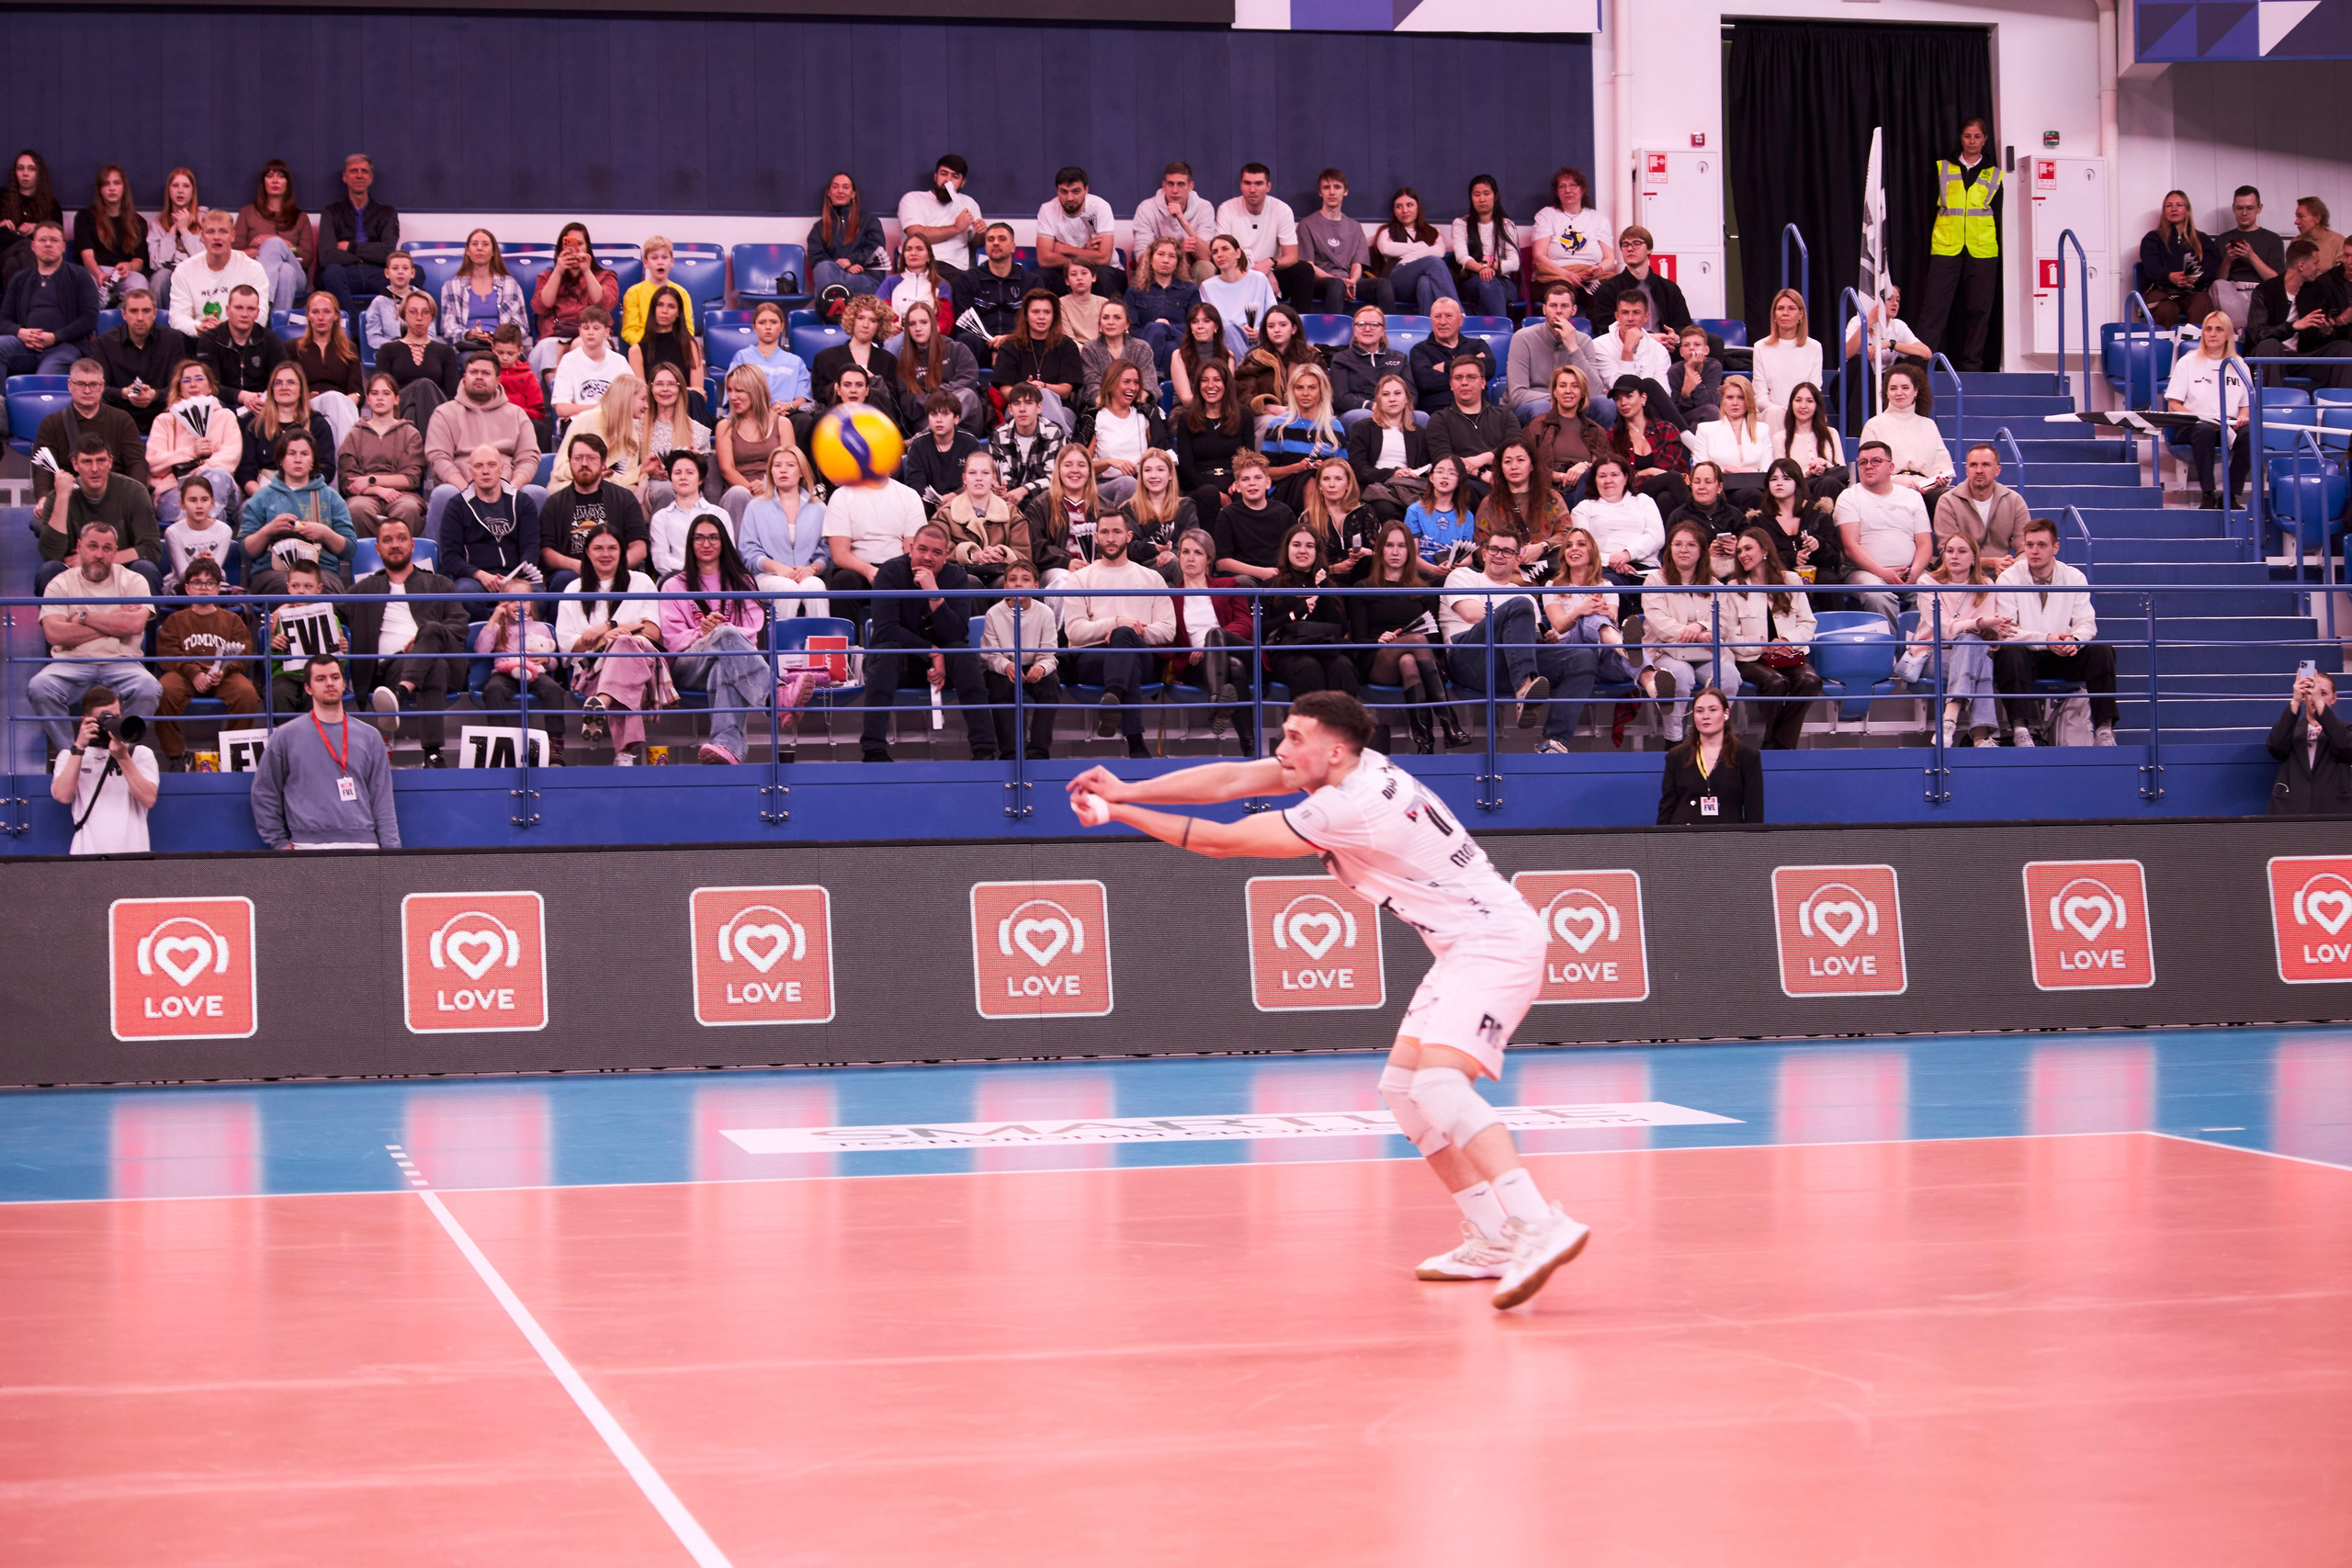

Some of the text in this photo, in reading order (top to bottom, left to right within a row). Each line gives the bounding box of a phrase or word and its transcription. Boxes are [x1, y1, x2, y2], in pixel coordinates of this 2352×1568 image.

[281, 614, 341, 661] FVL
[2061, 950, 2126, 969] LOVE
[2303, 943, 2352, 964] LOV
[1549, 963, 1618, 983] LOVE
[1809, 956, 1877, 976] LOVE
[1008, 976, 1080, 997] LOVE
[1283, 969, 1354, 989] LOVE
[437, 989, 514, 1010] LOVE
[727, 982, 802, 1003] LOVE
[145, 995, 223, 1018] LOVE
